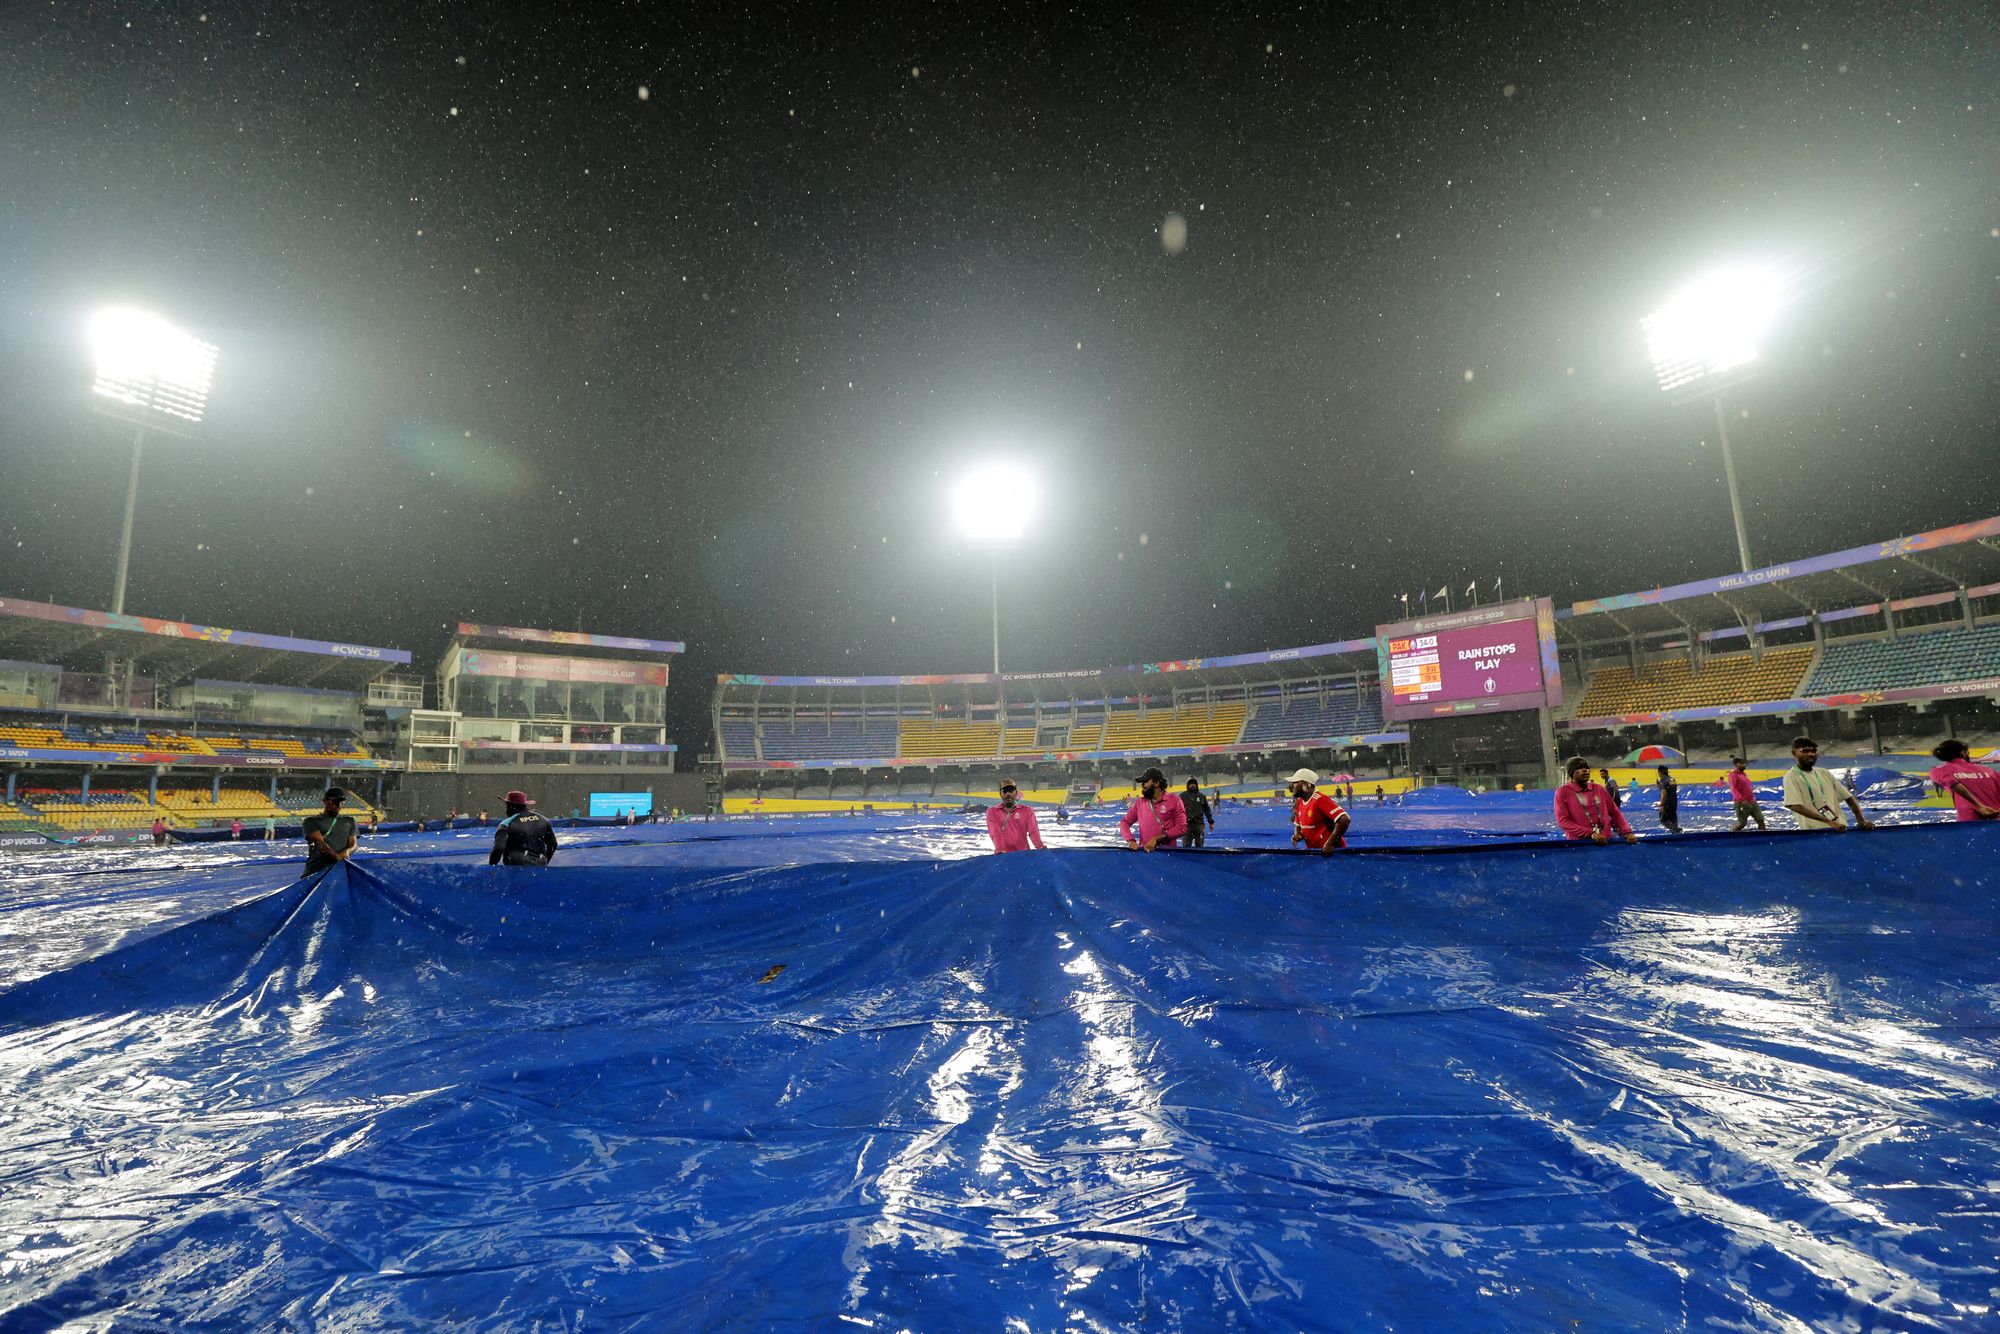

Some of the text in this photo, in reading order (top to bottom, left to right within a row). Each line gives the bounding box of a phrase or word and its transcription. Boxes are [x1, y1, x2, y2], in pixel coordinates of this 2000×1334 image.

[1719, 567, 1790, 588] WILL TO WIN
[1436, 617, 1467, 627] WOMEN'S
[1468, 614, 1484, 622] CWC
[1484, 611, 1504, 619] 2025
[332, 645, 380, 657] #CWC25
[1392, 642, 1407, 651] PAK
[1458, 643, 1516, 660] RAIN STOPS
[1270, 650, 1299, 659] #CWC25
[1474, 658, 1501, 671] PLAY
[1719, 705, 1751, 714] #CWC25
[1, 837, 47, 847] DP WORLD
